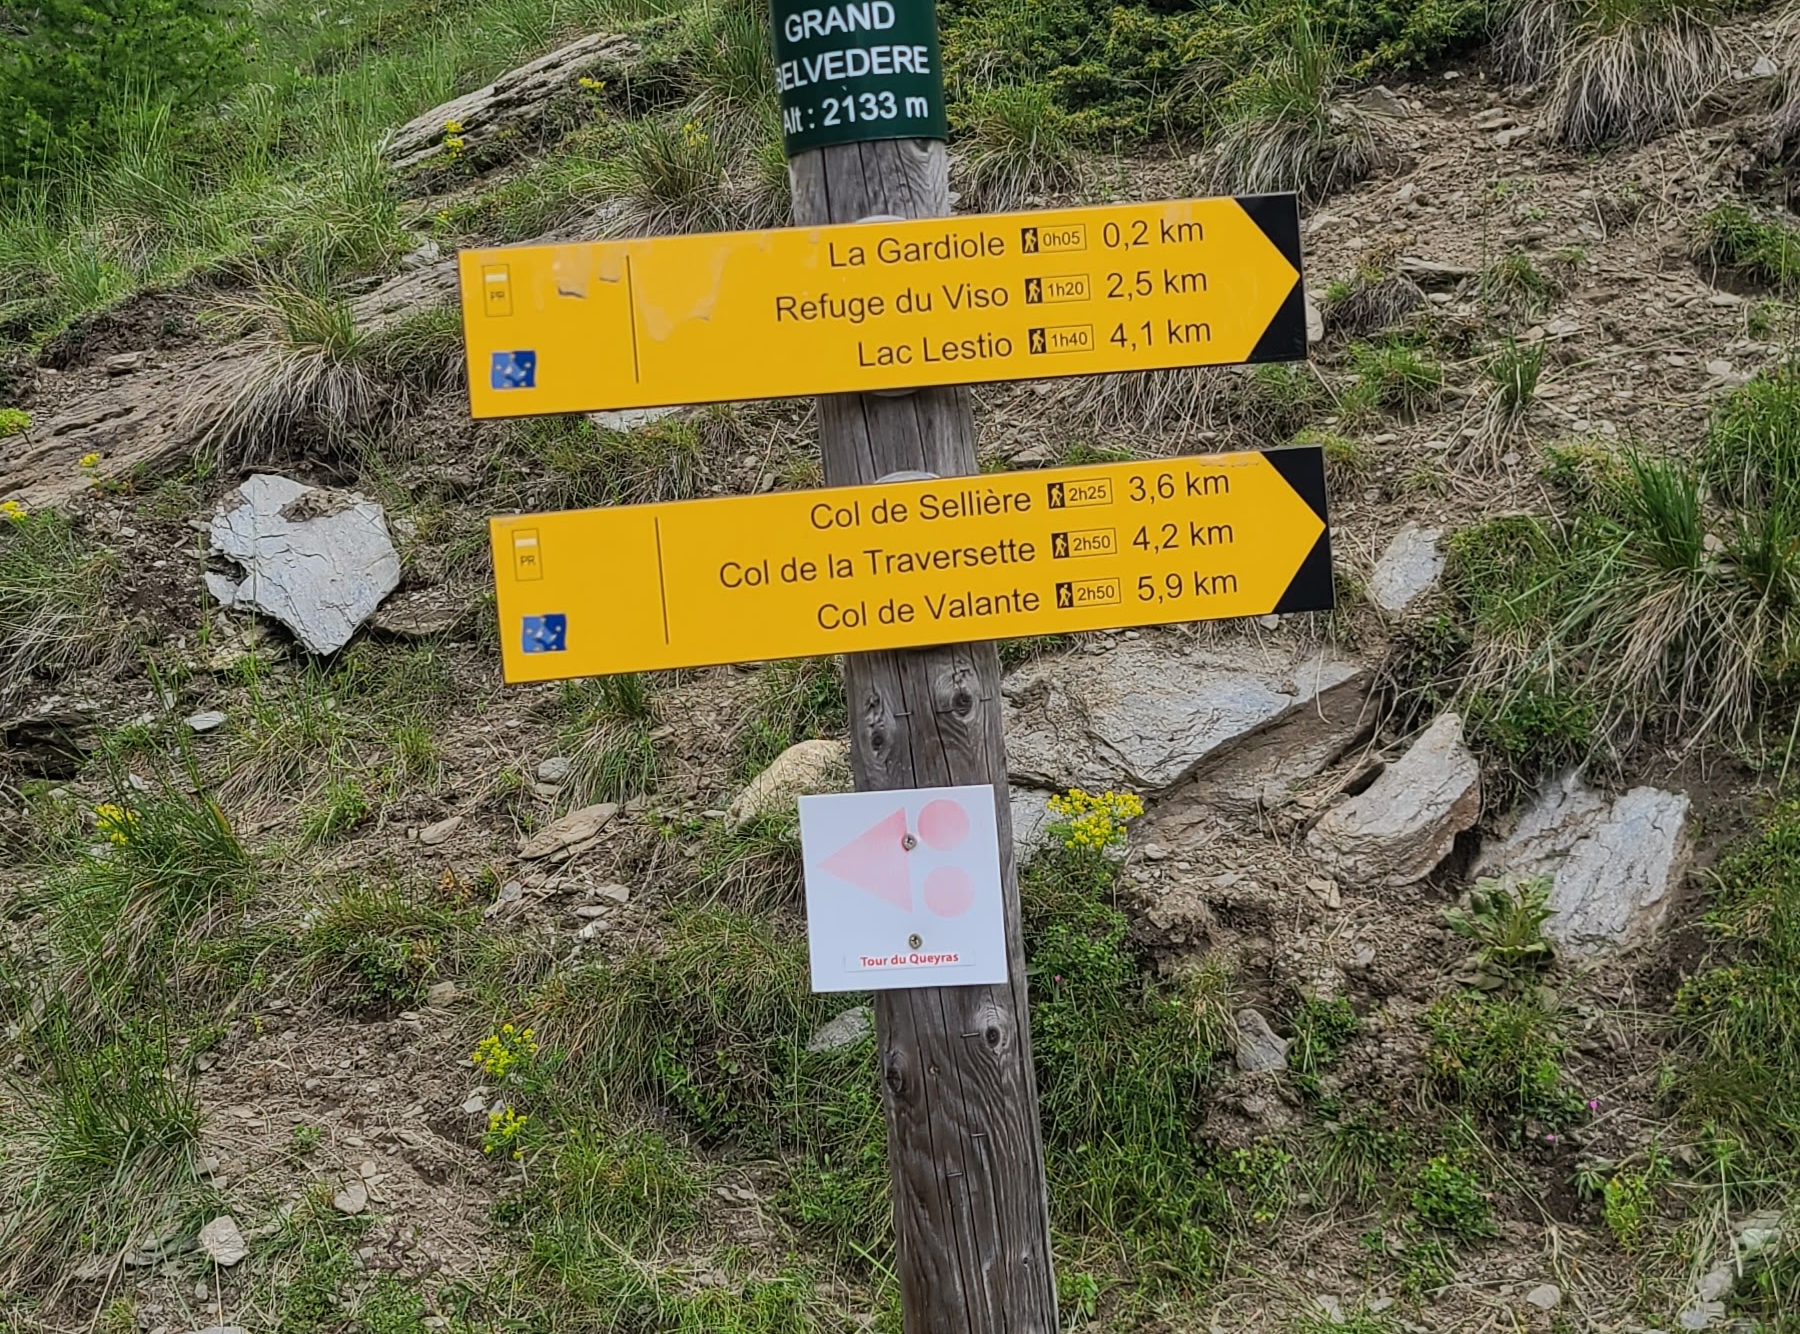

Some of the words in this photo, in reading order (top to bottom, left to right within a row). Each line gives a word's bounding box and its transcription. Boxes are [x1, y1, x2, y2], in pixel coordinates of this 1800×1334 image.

[785, 1, 895, 42] GRAND
[784, 107, 803, 136] Alt
[822, 91, 897, 126] 2133
[906, 97, 928, 118] m
[829, 242, 866, 268] La
[877, 231, 1005, 264] Gardiole
[1042, 230, 1081, 247] 0h05
[1103, 219, 1149, 251] 0,2
[1159, 218, 1204, 244] km
[775, 292, 885, 324] Refuge
[895, 287, 932, 314] du
[941, 282, 1009, 310] Viso
[1048, 281, 1084, 297] 1h20
[1106, 270, 1153, 302] 2,5
[1163, 268, 1207, 295] km
[858, 341, 913, 367] Lac
[922, 332, 1013, 363] Lestio
[1051, 331, 1088, 347] 1h40
[1109, 320, 1152, 352] 4,1
[1167, 318, 1211, 345] km
[810, 500, 860, 530] Col
[871, 498, 908, 525] de
[919, 488, 1032, 521] Sellière
[1068, 484, 1107, 502] 2h25
[1128, 473, 1175, 505] 3,6
[1185, 471, 1230, 497] km
[520, 555, 536, 566] PR
[719, 559, 770, 589] Col
[780, 556, 817, 583] de
[828, 553, 854, 579] la
[862, 538, 1036, 576] Traversette
[1072, 535, 1111, 552] 2h50
[1132, 523, 1179, 554] 4,2
[1189, 521, 1234, 547] km
[817, 600, 867, 630] Col
[878, 598, 915, 625] de
[923, 588, 1040, 620] Valante
[1077, 584, 1115, 602] 2h50
[1137, 572, 1183, 604] 5,9
[1193, 570, 1238, 597] km
[860, 956, 888, 966] Tour
[891, 955, 906, 965] du
[910, 953, 958, 965] Queyras
